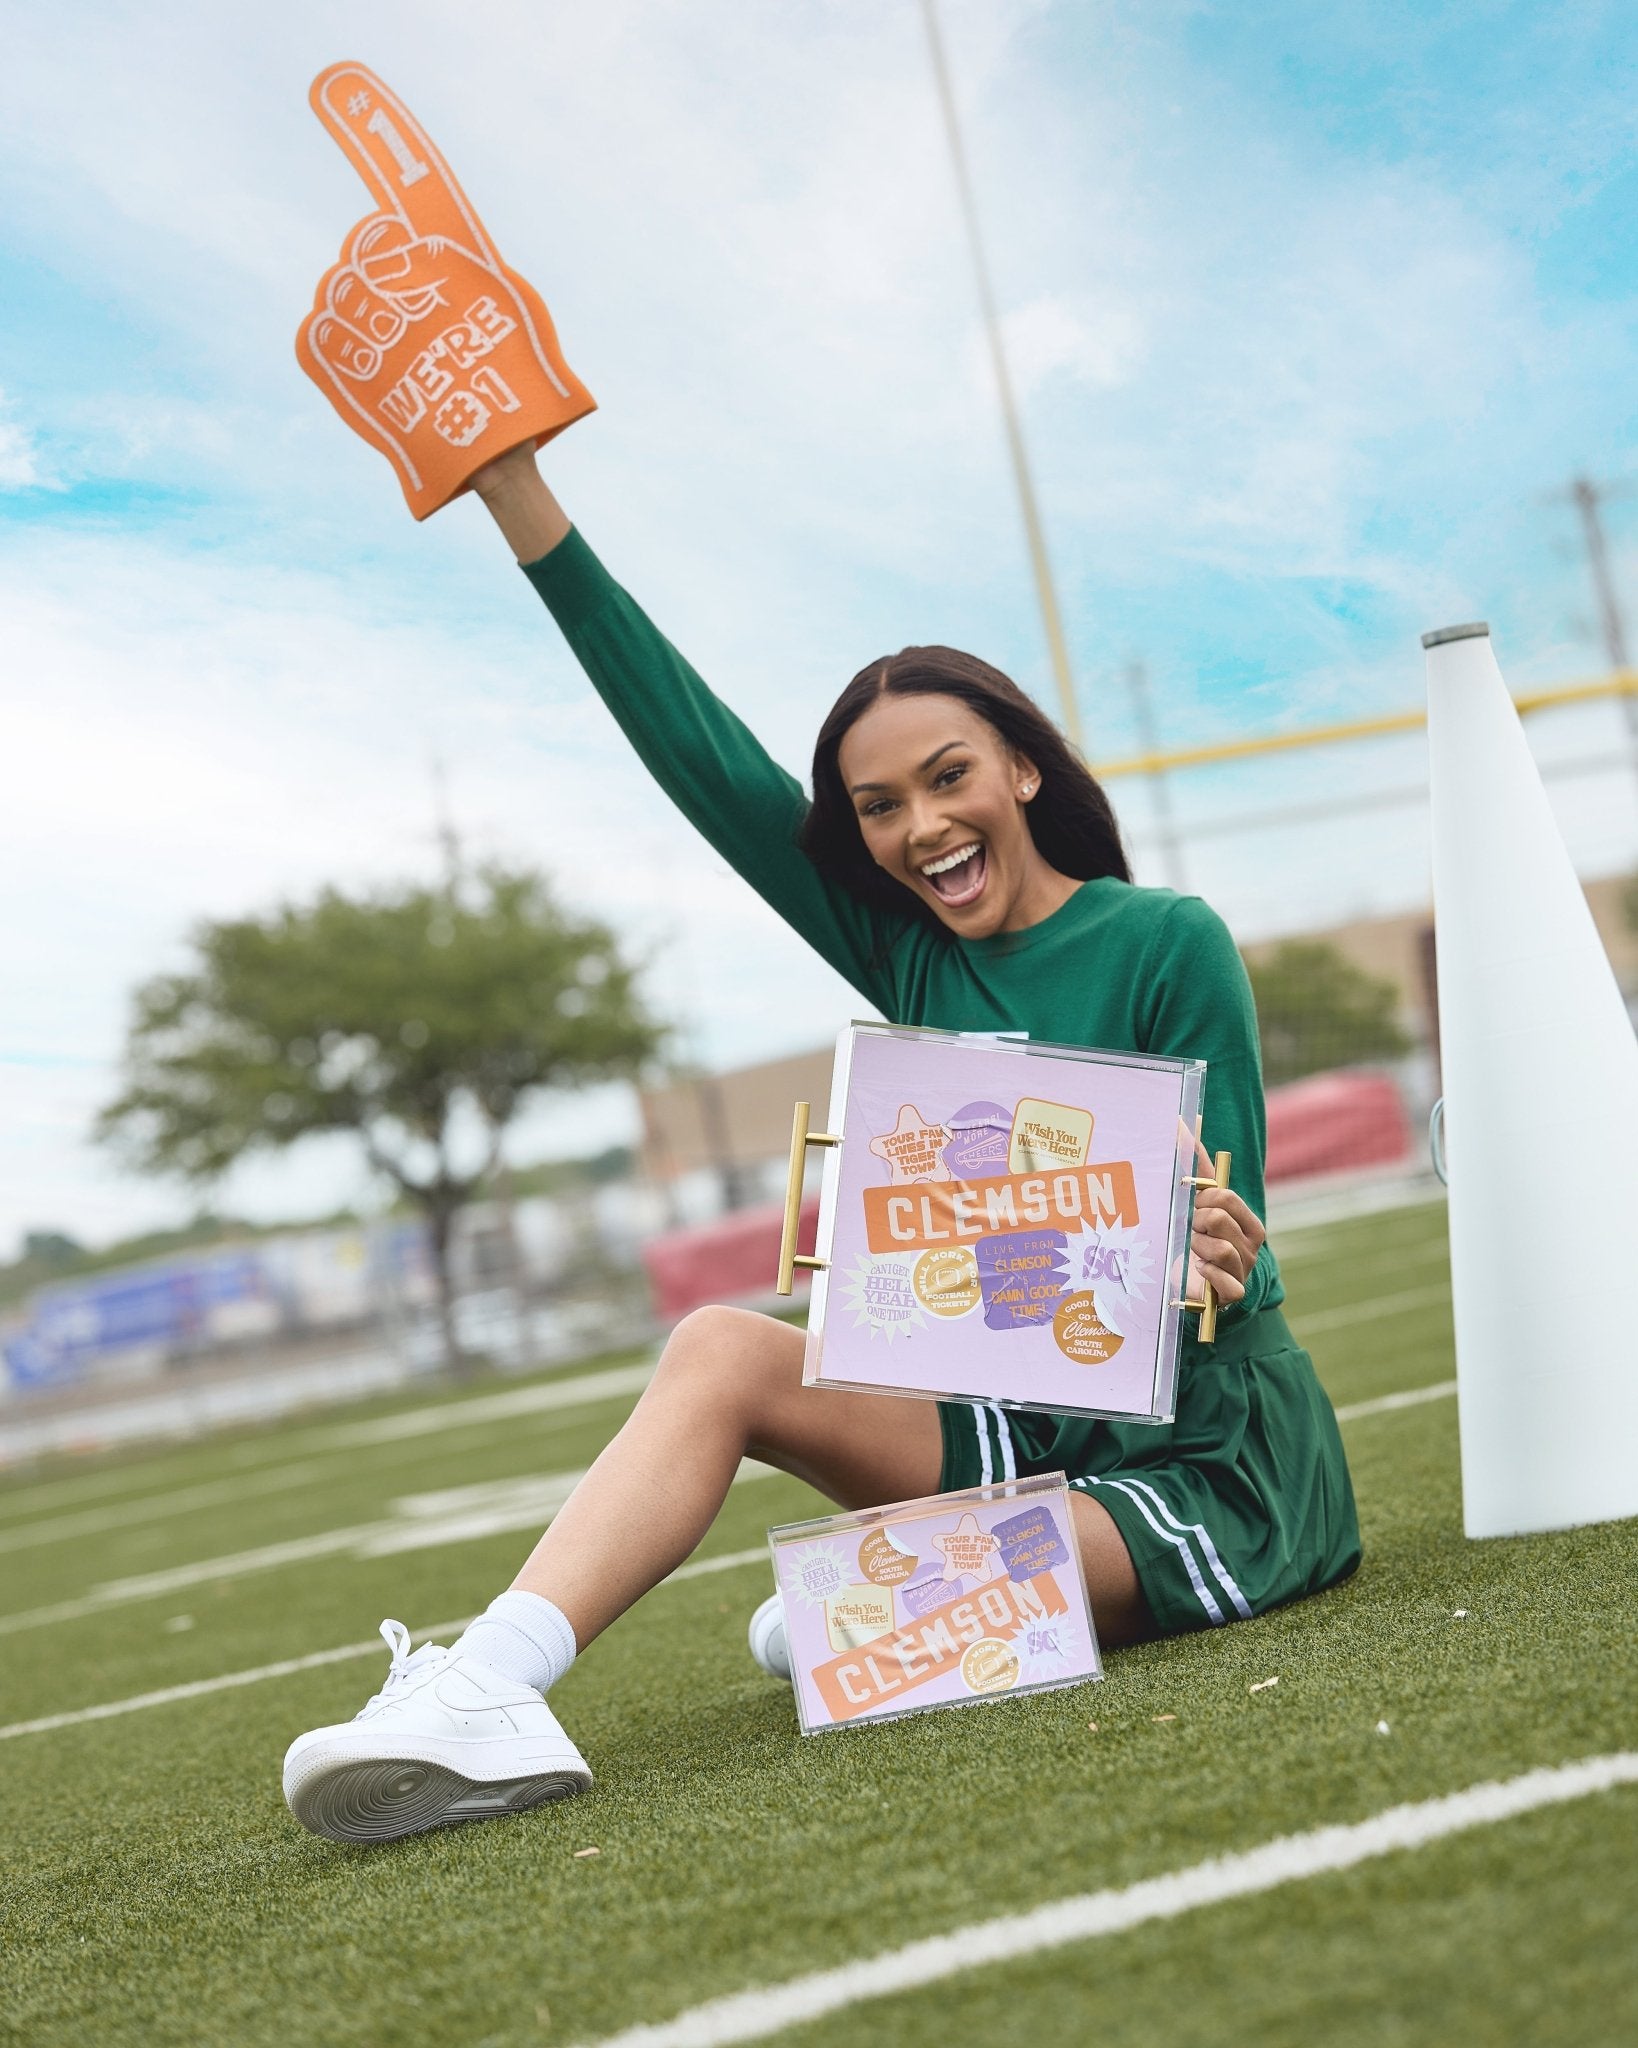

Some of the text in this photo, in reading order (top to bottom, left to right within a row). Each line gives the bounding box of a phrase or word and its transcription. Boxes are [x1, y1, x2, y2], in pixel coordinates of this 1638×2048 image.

[348, 91, 430, 188] #1
[380, 296, 517, 432] WE'RE
[433, 365, 521, 447] #1
[882, 1128, 944, 1148] YOUR FAV
[1024, 1122, 1078, 1146] Wish You
[887, 1138, 943, 1157] LIVES IN
[962, 1143, 1003, 1160] CHEERS
[1017, 1133, 1047, 1150] Were
[1048, 1140, 1082, 1158] Here!
[897, 1150, 936, 1165] TIGER
[900, 1161, 936, 1175] TOWN
[887, 1172, 1116, 1241] CLEMSON
[985, 1239, 1055, 1256] LIVE FROM
[995, 1254, 1052, 1273] CLEMSON
[1082, 1245, 1130, 1283] SC
[918, 1251, 978, 1295] WILL WORK FOR
[863, 1289, 918, 1308] YEAH
[926, 1291, 974, 1300] FOOTBALL
[991, 1284, 1062, 1304] DAMN GOOD
[867, 1305, 886, 1320] ONE
[931, 1300, 970, 1309] TICKETS
[1009, 1302, 1047, 1319] TIME!
[1064, 1299, 1089, 1313] GOOD
[1078, 1313, 1091, 1321] GO
[1074, 1339, 1103, 1348] SOUTH
[1066, 1346, 1109, 1358] CAROLINA
[943, 1535, 994, 1545] YOUR FAV
[1006, 1524, 1046, 1546] CLEMSON
[864, 1536, 884, 1552] GOOD
[877, 1546, 888, 1554] GO
[944, 1544, 992, 1552] LIVES IN
[1034, 1540, 1057, 1556] GOOD
[951, 1553, 984, 1561] TIGER
[801, 1563, 839, 1581] HELL
[879, 1565, 903, 1575] SOUTH
[953, 1561, 983, 1570] TOWN
[803, 1571, 841, 1591] YEAH
[874, 1571, 911, 1582] CAROLINA
[835, 1603, 883, 1616] Wish You
[831, 1612, 889, 1628] Were Here!
[835, 1578, 1045, 1704] CLEMSON
[972, 1645, 999, 1658] WORK
